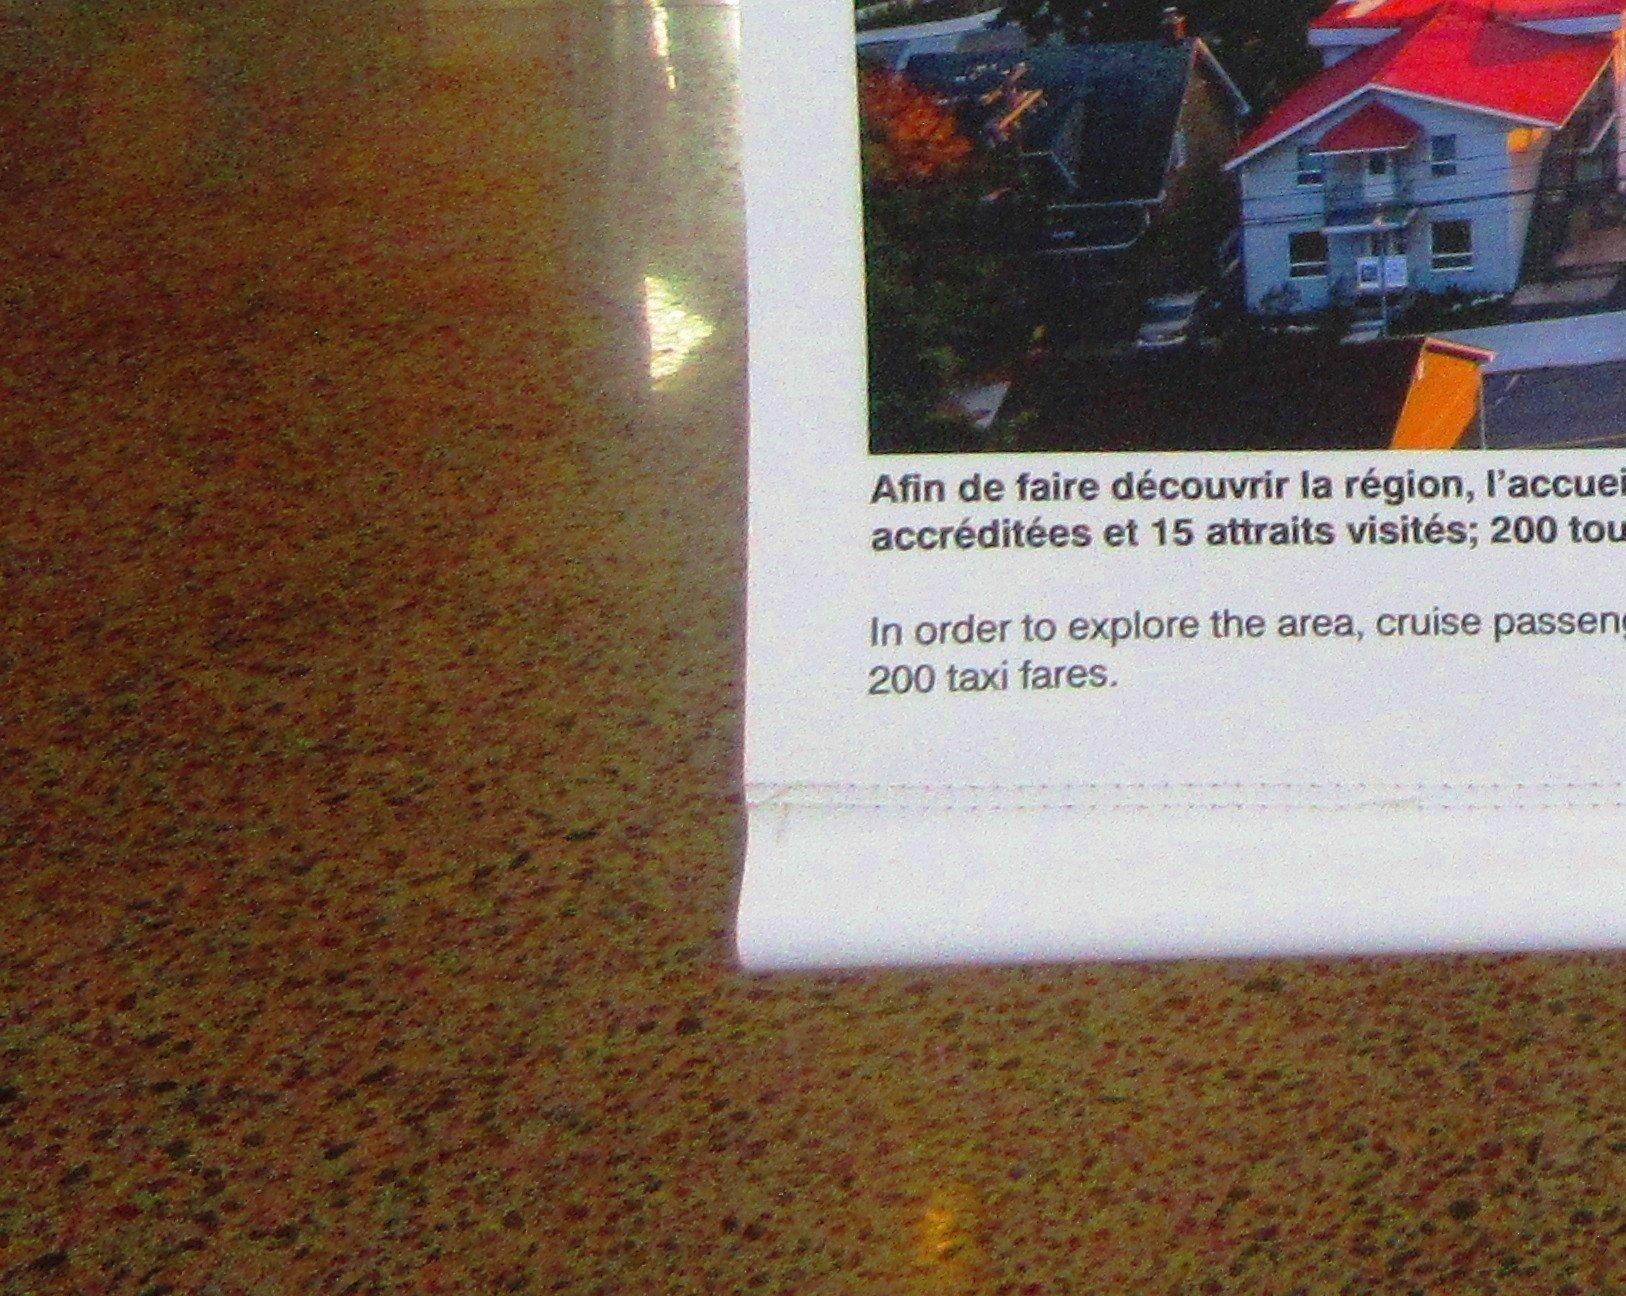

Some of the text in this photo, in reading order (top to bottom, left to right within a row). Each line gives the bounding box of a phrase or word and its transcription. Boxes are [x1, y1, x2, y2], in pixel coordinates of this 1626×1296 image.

[870, 472, 946, 504] Afin
[957, 472, 1005, 504] de
[1015, 471, 1100, 503] faire
[1110, 468, 1290, 502] découvrir
[1300, 469, 1333, 500] la
[1344, 467, 1475, 507] région,
[871, 515, 1093, 553] accréditées
[1103, 518, 1139, 548] et
[1151, 517, 1195, 547] 15
[1205, 515, 1336, 547] attraits
[1346, 512, 1478, 550] visités;
[1490, 514, 1558, 545] 200
[871, 616, 903, 647] In
[914, 613, 1012, 647] order
[1021, 614, 1057, 643] to
[1068, 610, 1200, 648] explore
[1209, 608, 1266, 639] the
[1277, 613, 1364, 642] area,
[1376, 606, 1482, 637] cruise
[868, 659, 1117, 696] 200 taxi fares.
